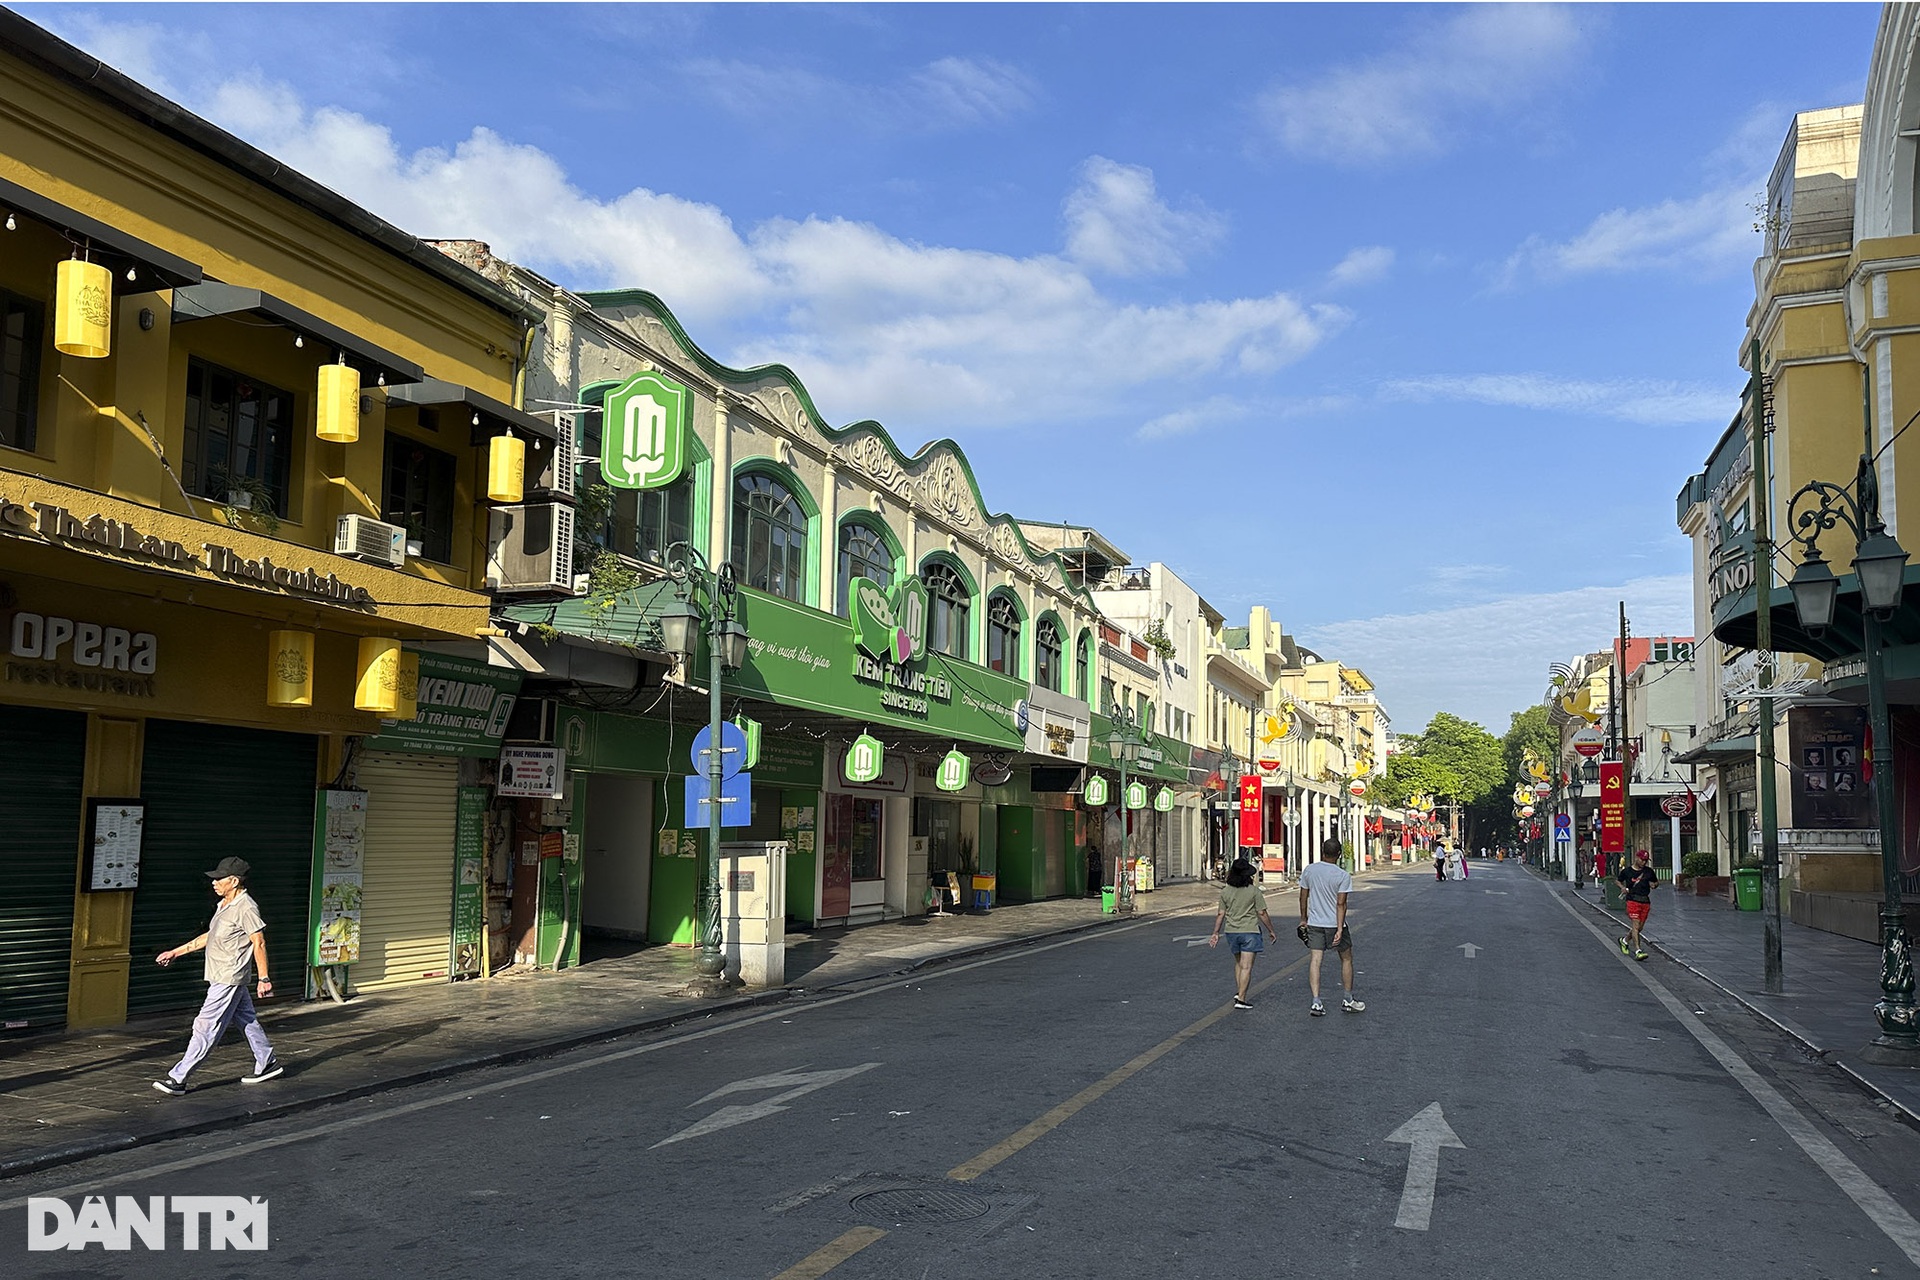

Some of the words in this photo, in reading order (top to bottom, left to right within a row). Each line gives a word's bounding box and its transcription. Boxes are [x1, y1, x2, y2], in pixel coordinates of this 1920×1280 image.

[852, 654, 883, 683] KEM
[417, 676, 462, 707] KEM
[880, 691, 908, 708] SINCE
[909, 696, 928, 713] 1958
[428, 710, 465, 728] TRÀNG
[464, 713, 488, 731] TIỀN
